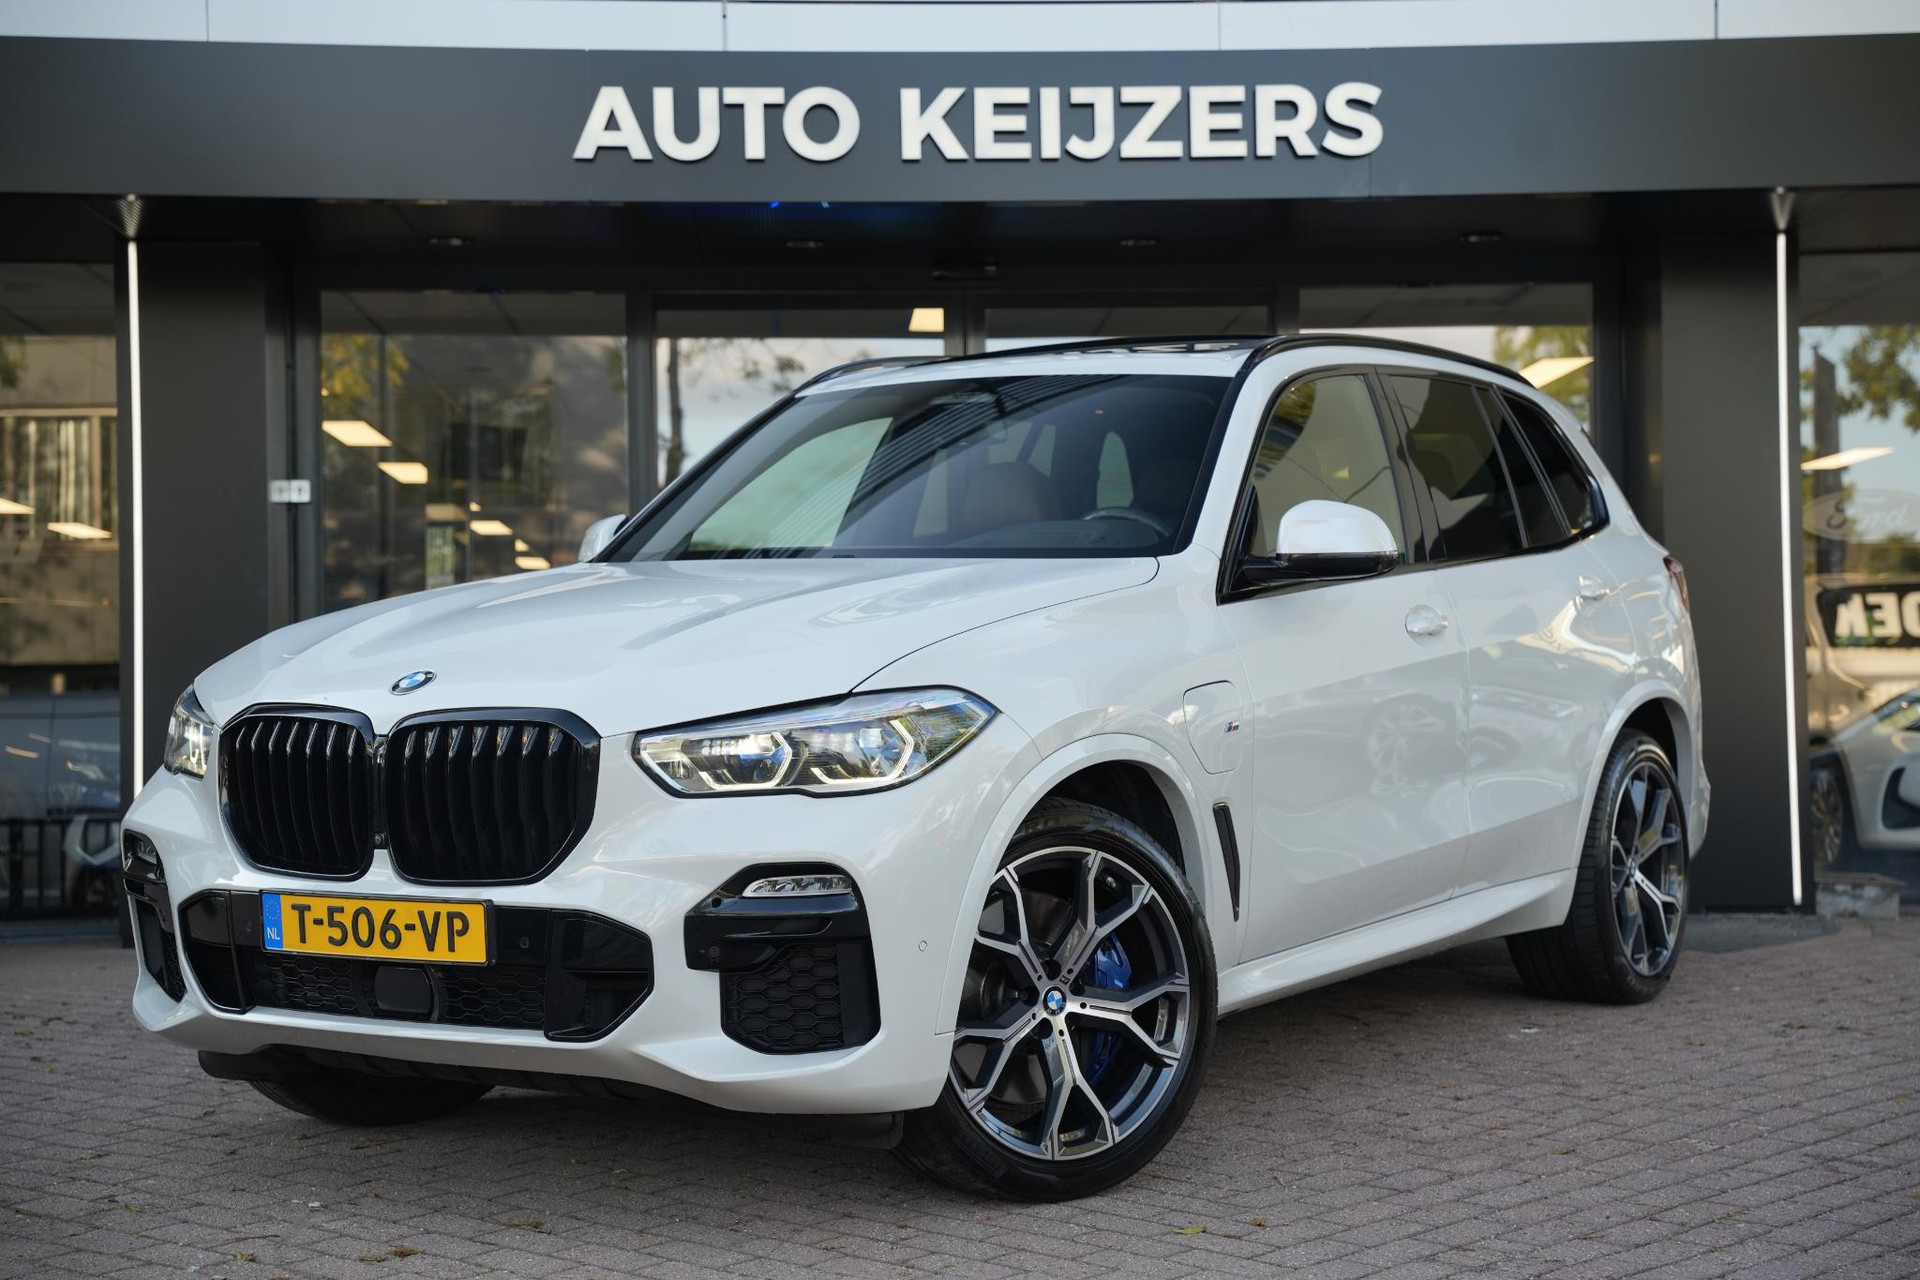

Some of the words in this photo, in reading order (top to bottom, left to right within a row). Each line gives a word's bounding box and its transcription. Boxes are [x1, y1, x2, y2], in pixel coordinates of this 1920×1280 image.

[572, 85, 861, 162] AUTO
[899, 81, 1384, 161] KEIJZERS
[266, 926, 281, 941] NL
[291, 903, 470, 953] T-506-VP
